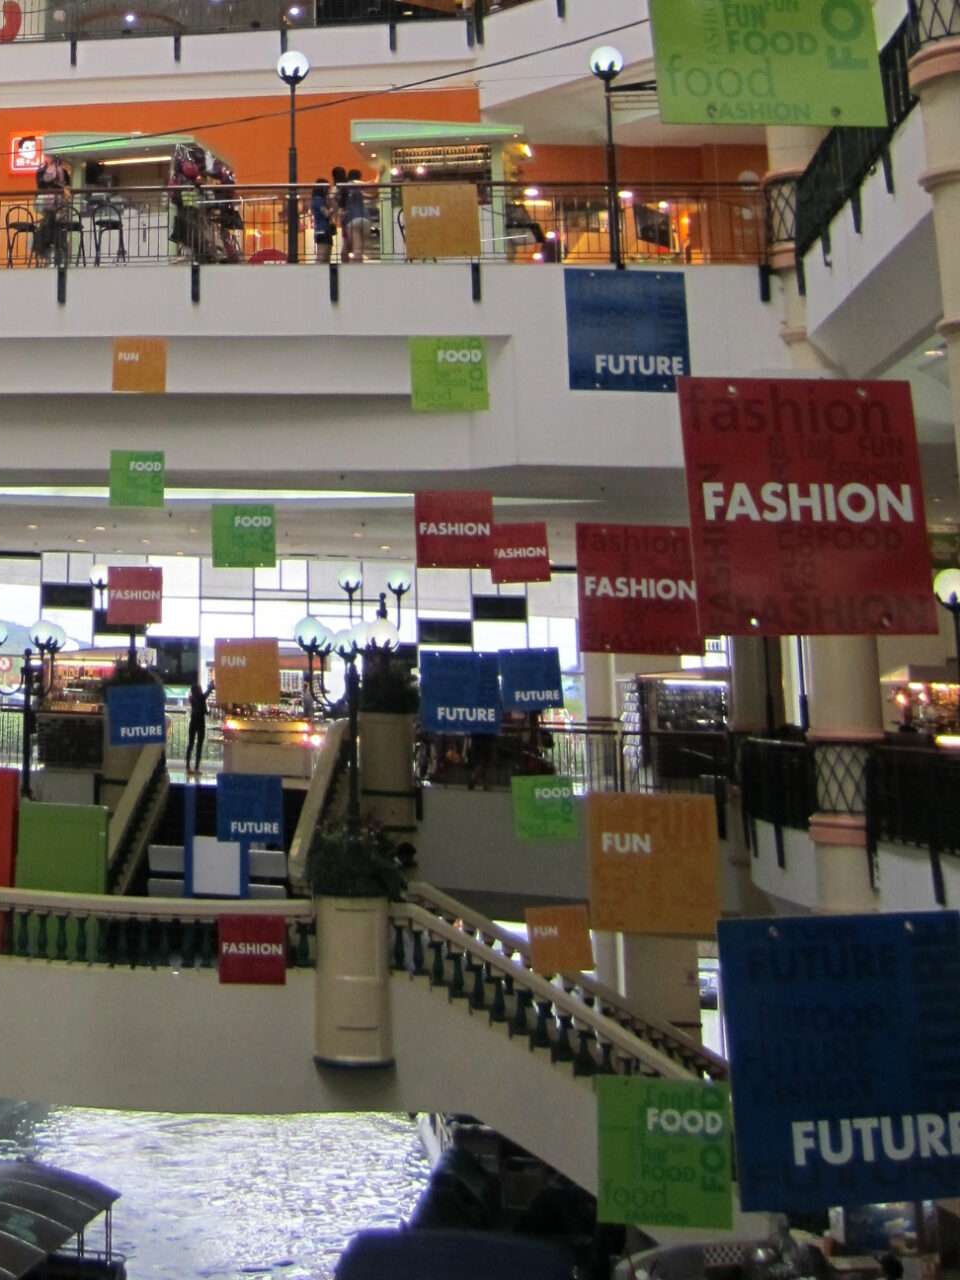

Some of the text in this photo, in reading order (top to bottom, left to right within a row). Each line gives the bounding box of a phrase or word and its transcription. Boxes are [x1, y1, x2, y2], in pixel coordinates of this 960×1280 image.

[727, 31, 818, 55] FOOD
[665, 54, 776, 97] food
[411, 205, 440, 218] FUN
[118, 351, 140, 363] FUN
[437, 349, 482, 363] FOOD
[594, 353, 684, 377] FUTURE
[129, 461, 162, 472] FOOD
[702, 482, 915, 523] FASHION
[234, 516, 272, 528] FOOD
[420, 522, 490, 536] FASHION
[110, 588, 161, 601] FASHION
[584, 576, 696, 601] FASHION
[220, 655, 246, 667] FUN
[514, 690, 561, 702] FUTURE
[437, 707, 496, 722] FUTURE
[120, 726, 162, 737] FUTURE
[534, 787, 571, 799] FOOD
[230, 821, 279, 834] FUTURE
[601, 832, 652, 854] FUN
[533, 926, 558, 937] FUN
[222, 942, 283, 955] FASHION
[647, 1108, 723, 1135] FOOD
